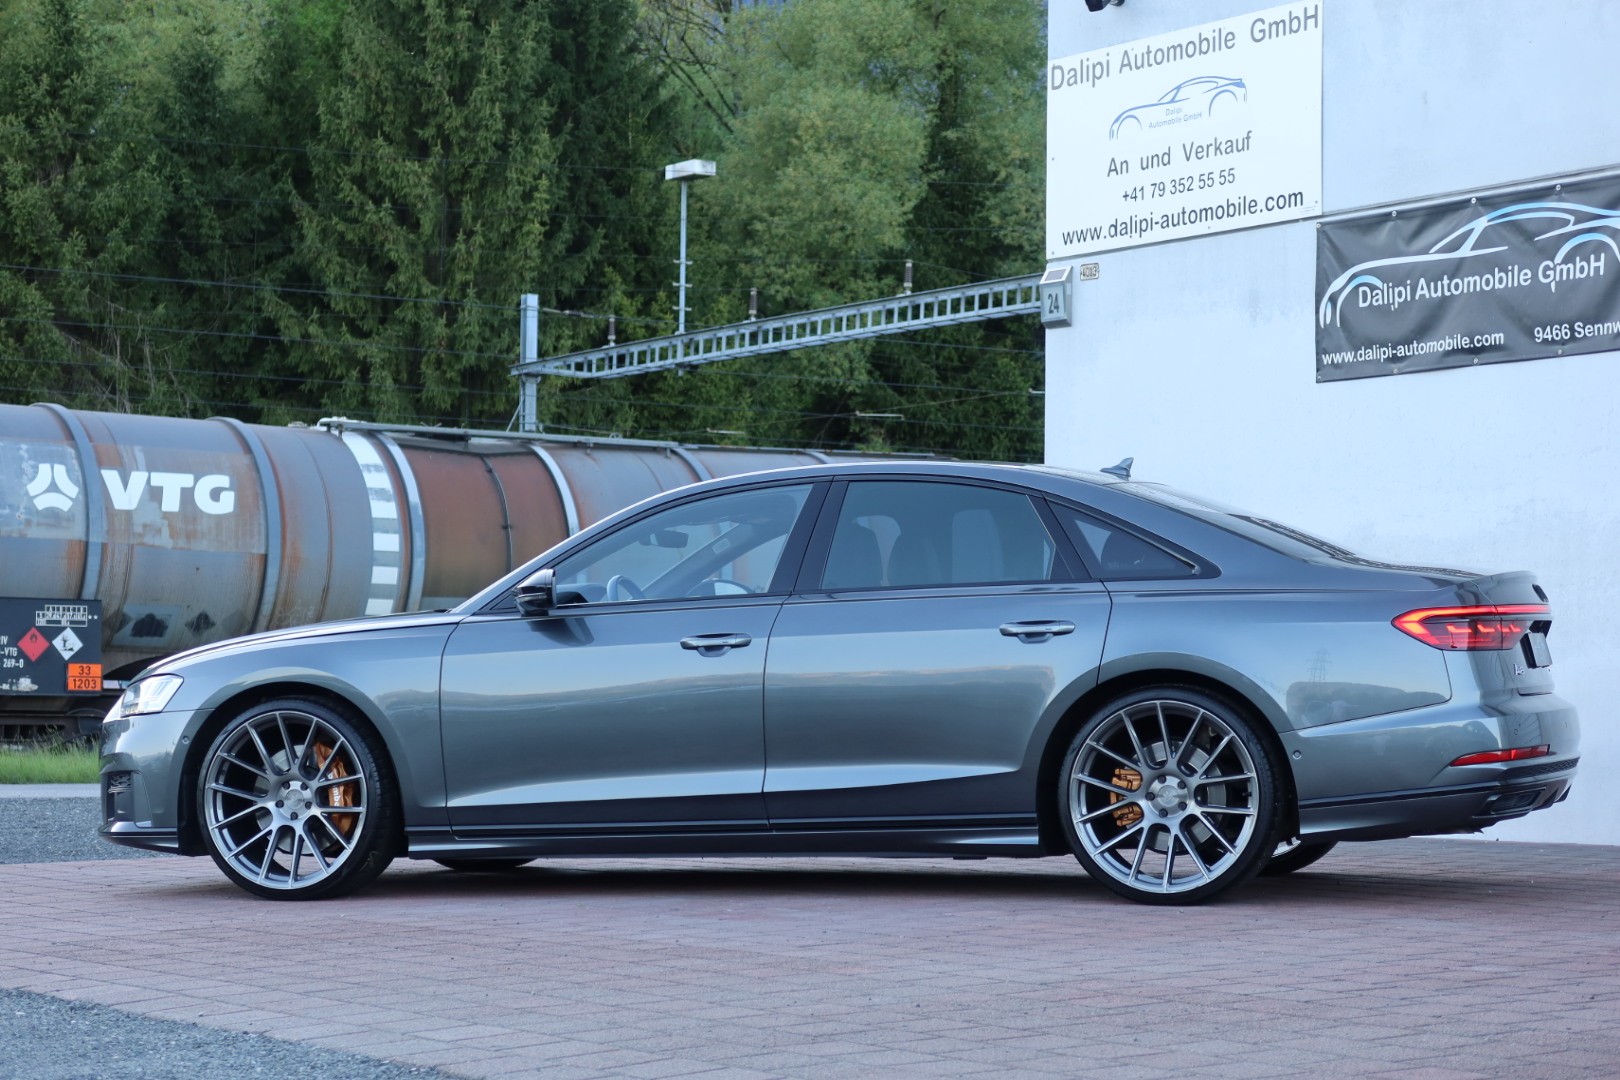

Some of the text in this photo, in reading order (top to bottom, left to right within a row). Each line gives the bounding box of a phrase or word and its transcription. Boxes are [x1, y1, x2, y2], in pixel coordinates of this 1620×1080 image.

[1051, 4, 1319, 90] Dalipi Automobile GmbH
[1107, 130, 1253, 177] An und Verkauf
[1122, 167, 1236, 202] +41 79 352 55 55
[1062, 191, 1304, 246] www.dalipi-automobile.com
[1358, 253, 1605, 309] Dalipi Automobile GmbH
[1048, 293, 1059, 314] 24
[1322, 331, 1505, 365] www.dalipi-automobile.com
[1534, 324, 1571, 343] 9466
[100, 469, 235, 514] VTG
[73, 679, 97, 689] 1203
[78, 665, 91, 676] 33
